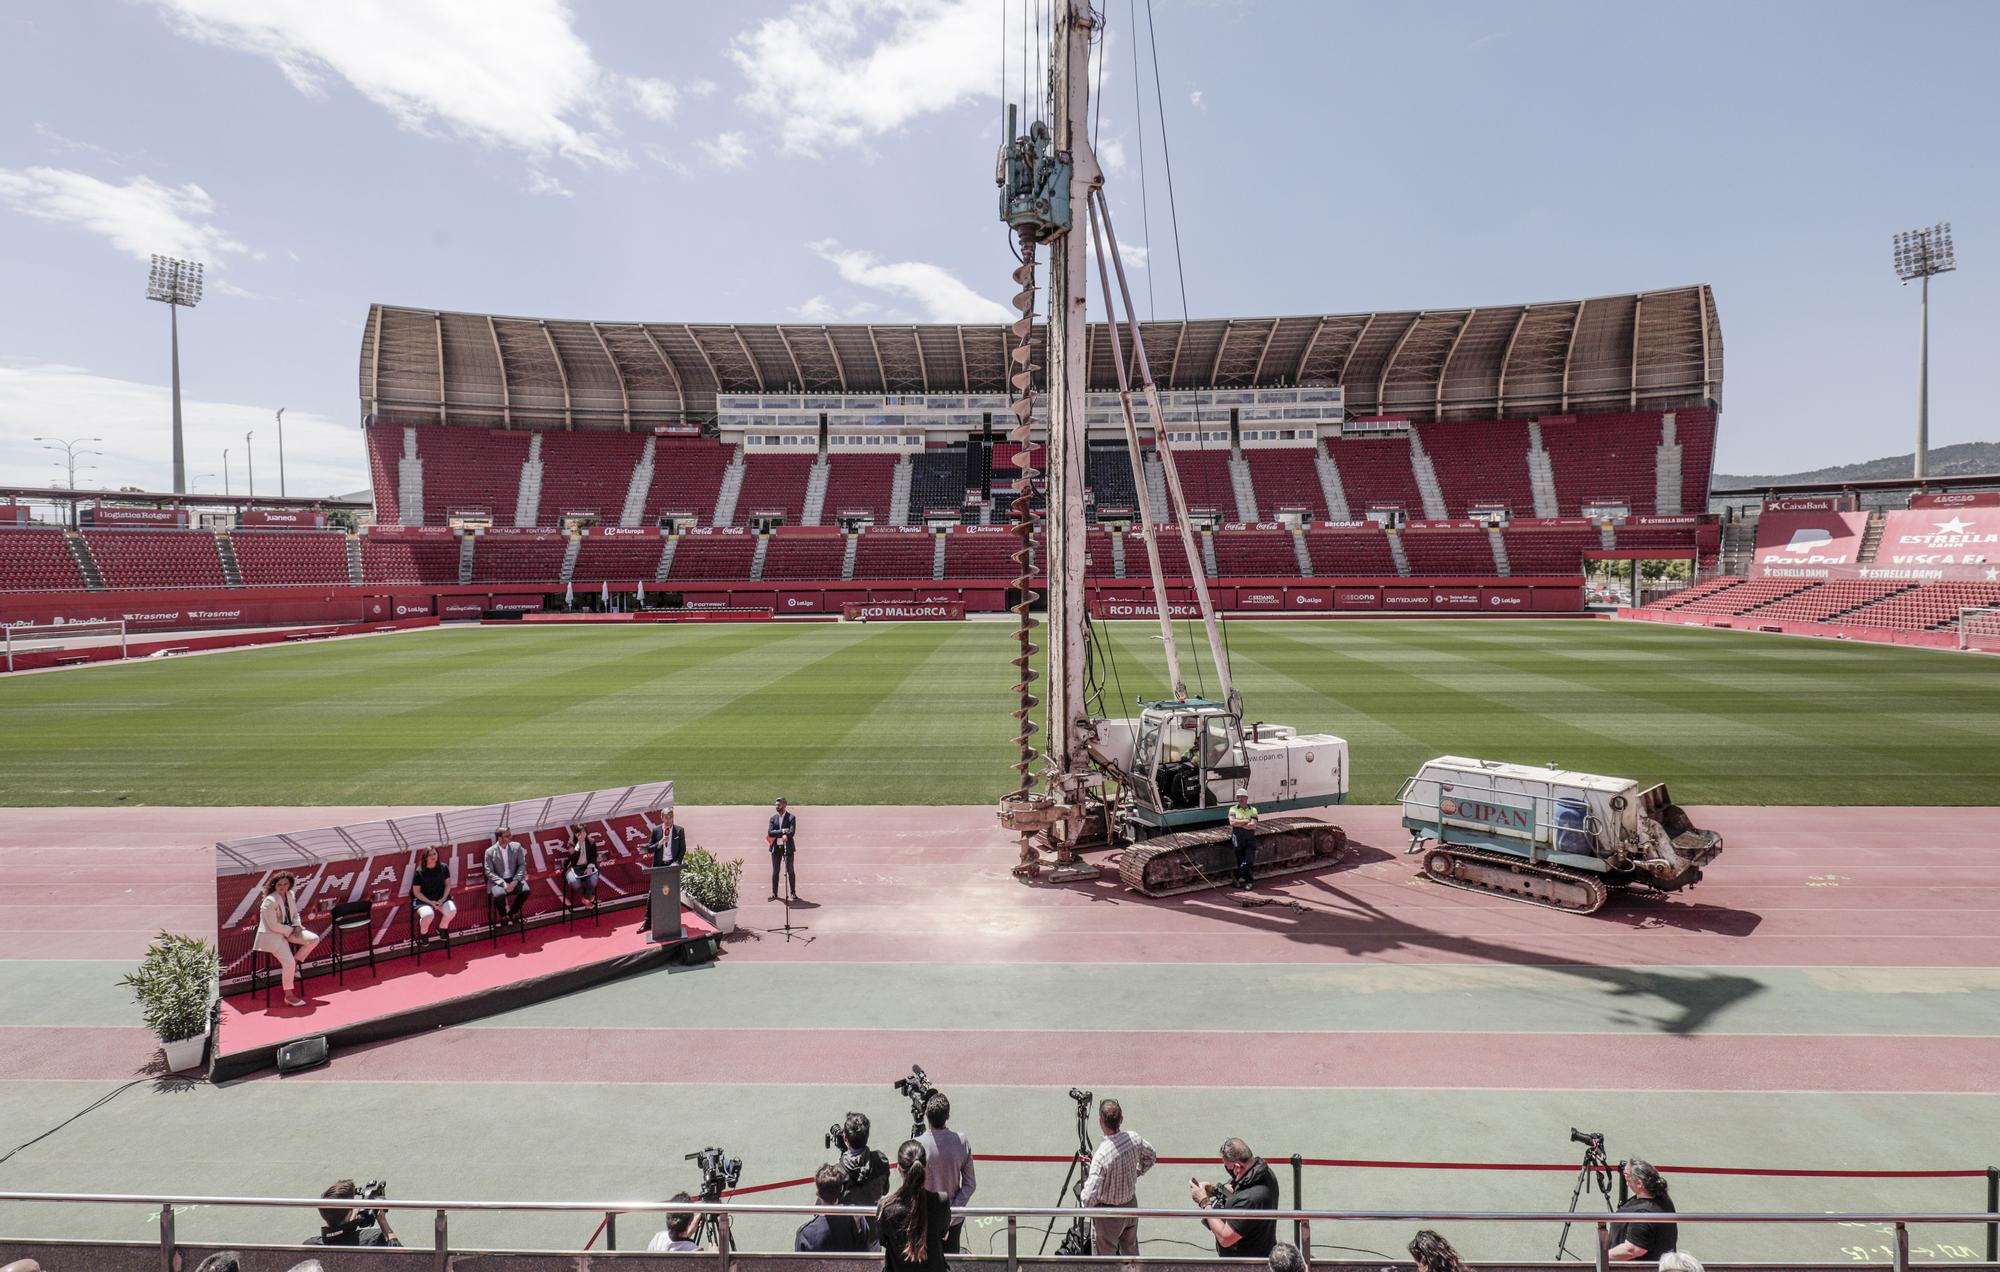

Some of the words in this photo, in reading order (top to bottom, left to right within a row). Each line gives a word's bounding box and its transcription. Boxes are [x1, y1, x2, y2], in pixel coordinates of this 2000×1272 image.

[1781, 502, 1828, 510] CaixaBank
[265, 513, 297, 522] juaneda
[1899, 534, 1998, 544] ESTRELLA
[1763, 555, 1847, 564] PayPal
[1772, 568, 1804, 577] ESTRELLA
[1805, 569, 1829, 577] DAMM
[1870, 569, 1911, 578] ESTRELLA
[1911, 569, 1943, 579] DAMM
[198, 610, 241, 618] Trasmed
[861, 607, 883, 616] RCD
[885, 606, 946, 616] MALLORCA
[1110, 606, 1133, 615] RCD
[1135, 606, 1197, 615] MALORCA
[133, 612, 179, 620] Trasmed
[1458, 801, 1529, 827] CIPAN
